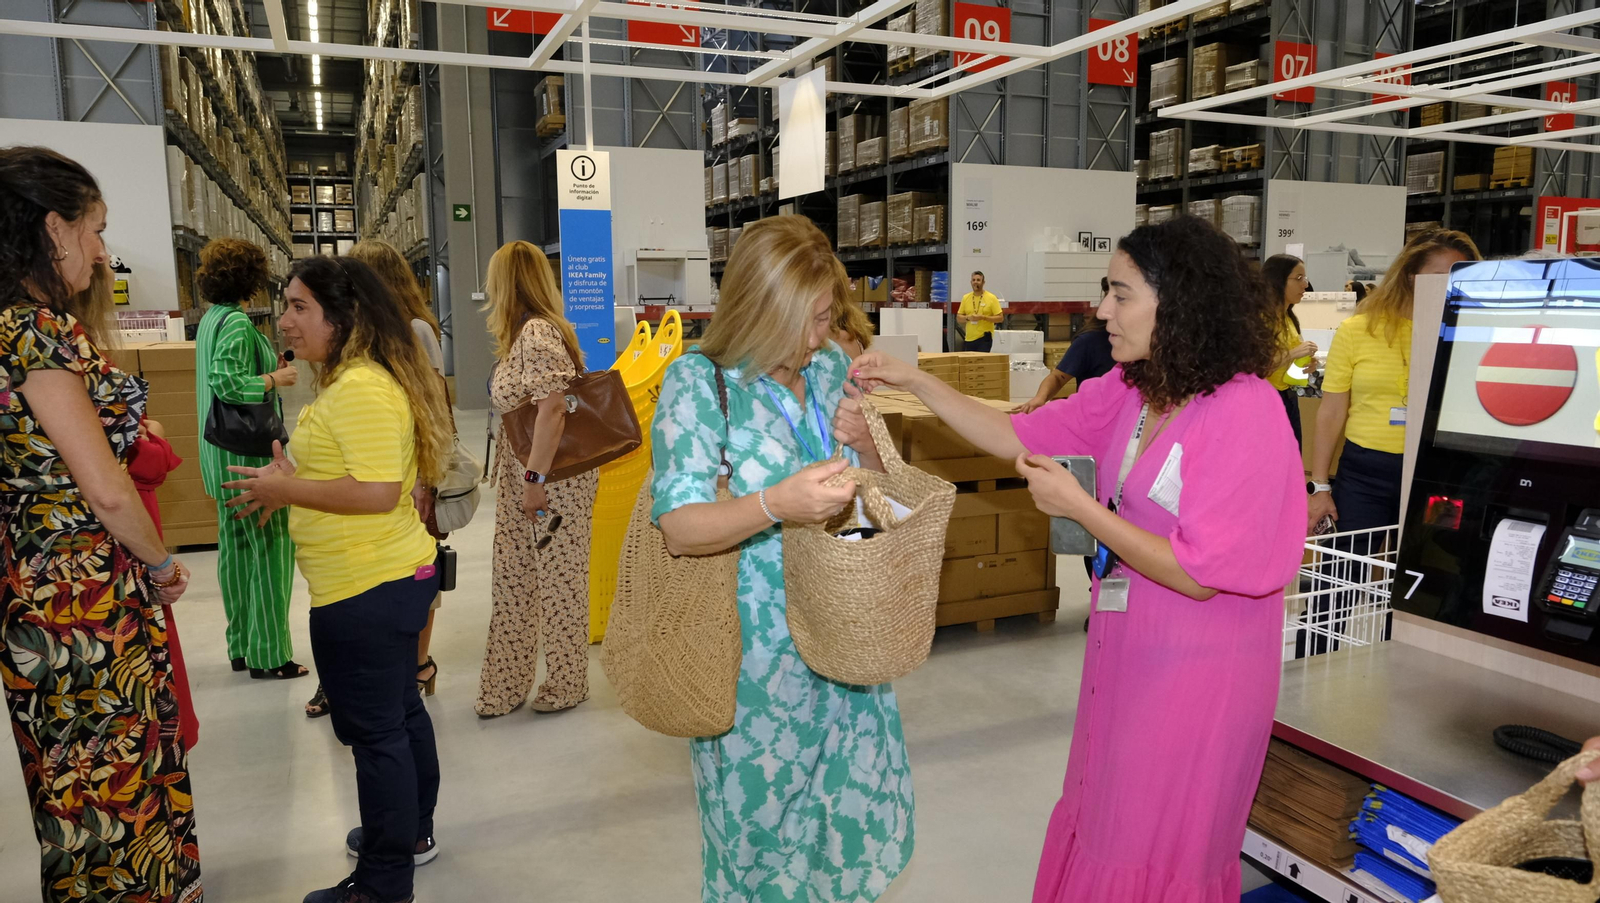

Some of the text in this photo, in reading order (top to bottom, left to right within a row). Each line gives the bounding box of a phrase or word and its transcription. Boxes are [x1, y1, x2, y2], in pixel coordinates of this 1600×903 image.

[963, 17, 1001, 43] 09
[1097, 35, 1130, 63] 08
[1281, 53, 1309, 80] 07
[966, 220, 988, 231] 169€
[1278, 228, 1295, 238] 399€
[588, 256, 606, 264] gratis
[584, 272, 606, 280] Family
[573, 279, 598, 287] disfruta
[578, 287, 604, 295] montón
[578, 296, 605, 304] ventajas
[574, 304, 605, 312] sorpresas
[1135, 416, 1146, 439] IKEA
[1403, 569, 1425, 600] 7
